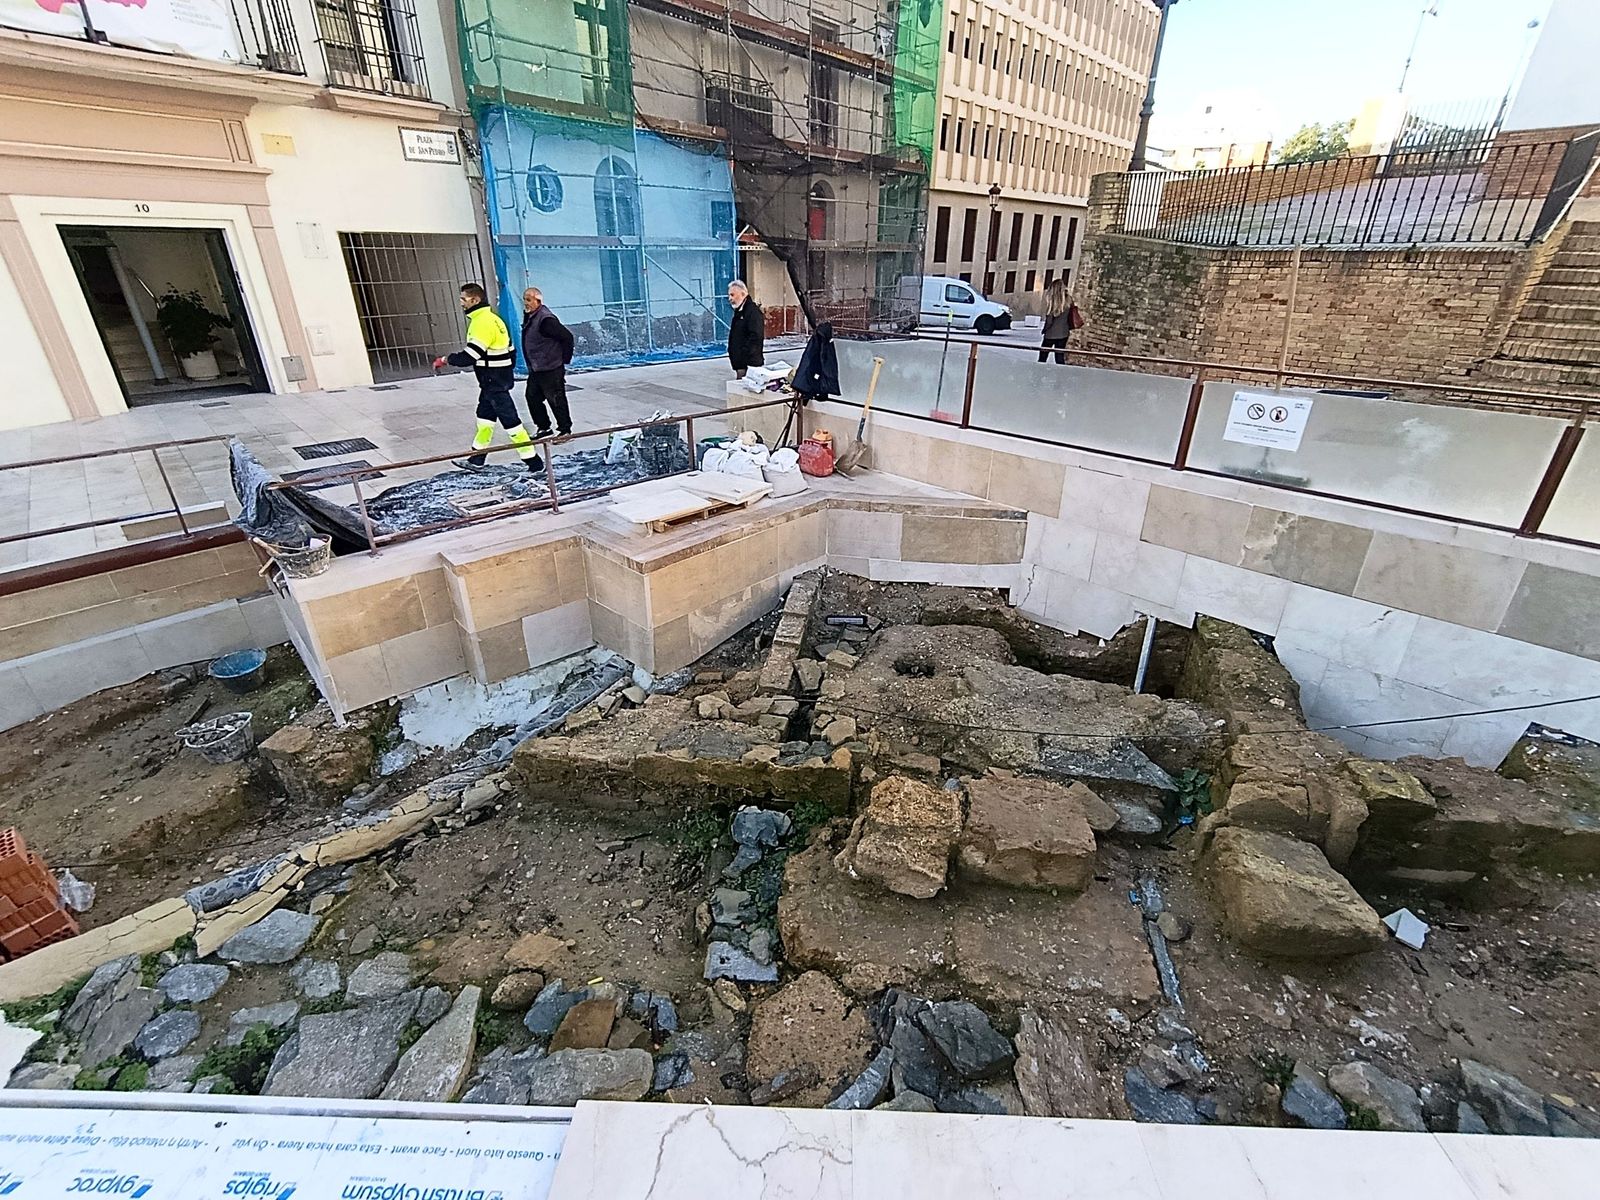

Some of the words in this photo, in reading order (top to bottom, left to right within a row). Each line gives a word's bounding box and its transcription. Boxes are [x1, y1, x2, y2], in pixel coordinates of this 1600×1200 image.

[416, 134, 432, 143] PLAZA
[418, 146, 429, 155] SAN
[429, 147, 446, 156] PEDRO
[135, 204, 150, 213] 10
[278, 1140, 304, 1152] fuera
[307, 1141, 334, 1152] hacia
[335, 1143, 358, 1153] cara
[359, 1144, 382, 1155] Esta
[390, 1145, 420, 1155] avant
[422, 1147, 448, 1157] Face
[455, 1147, 482, 1158] fuori
[484, 1149, 505, 1159] lato
[506, 1150, 544, 1161] Questo
[65, 1174, 139, 1194] gyproc
[223, 1177, 281, 1200] rigips
